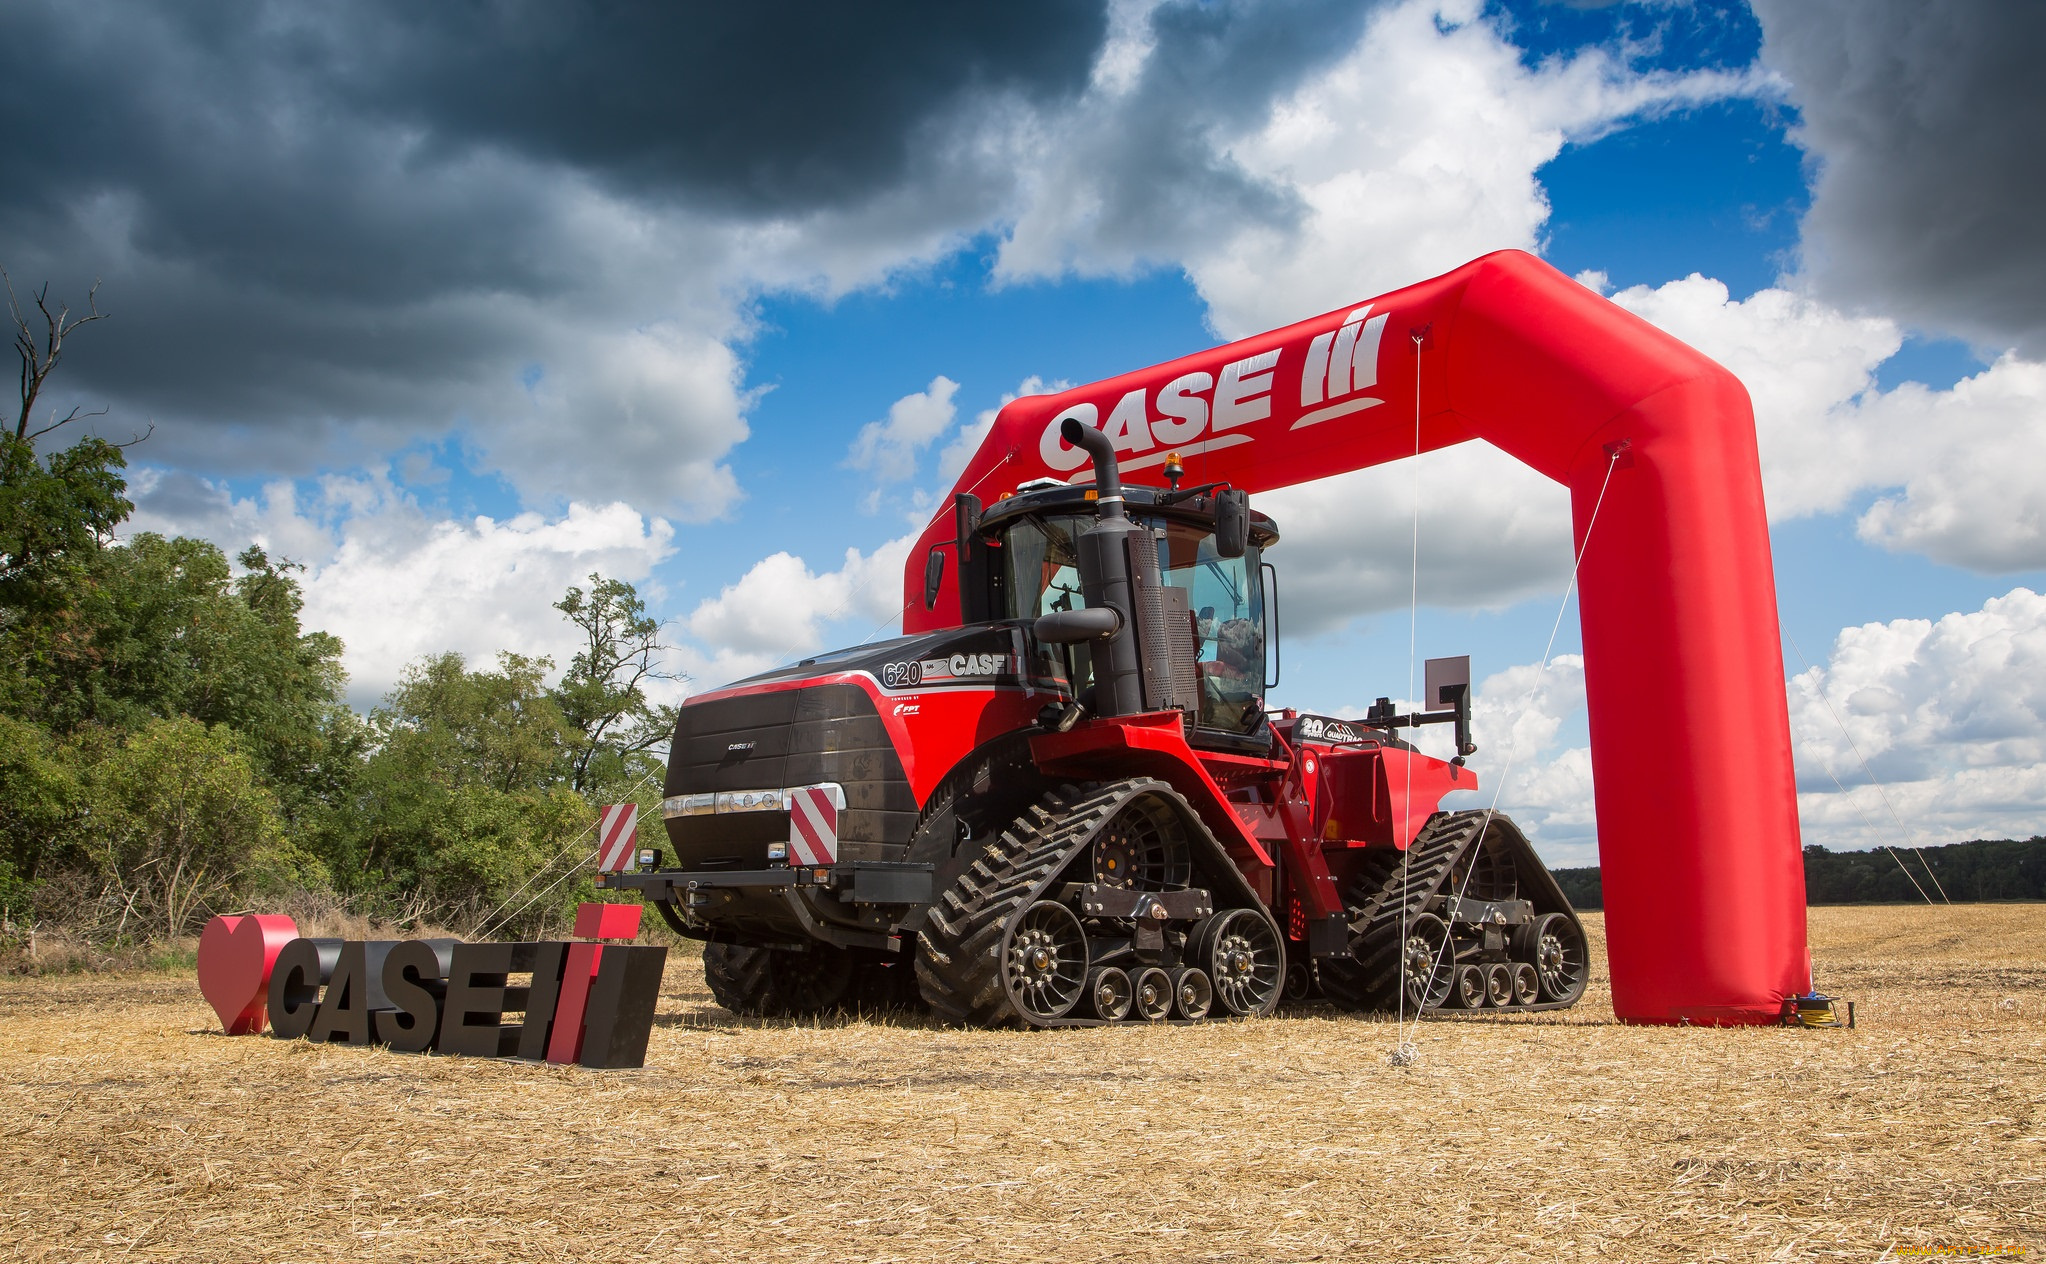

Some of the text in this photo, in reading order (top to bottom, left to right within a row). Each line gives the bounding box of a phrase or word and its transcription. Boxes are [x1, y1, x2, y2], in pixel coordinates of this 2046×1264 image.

[1040, 348, 1283, 472] CASE
[882, 661, 922, 687] 620
[949, 654, 1005, 676] CASE
[902, 705, 920, 713] FPT
[1300, 718, 1324, 736] 20
[728, 743, 747, 751] CASE
[268, 937, 514, 1057] CASE
